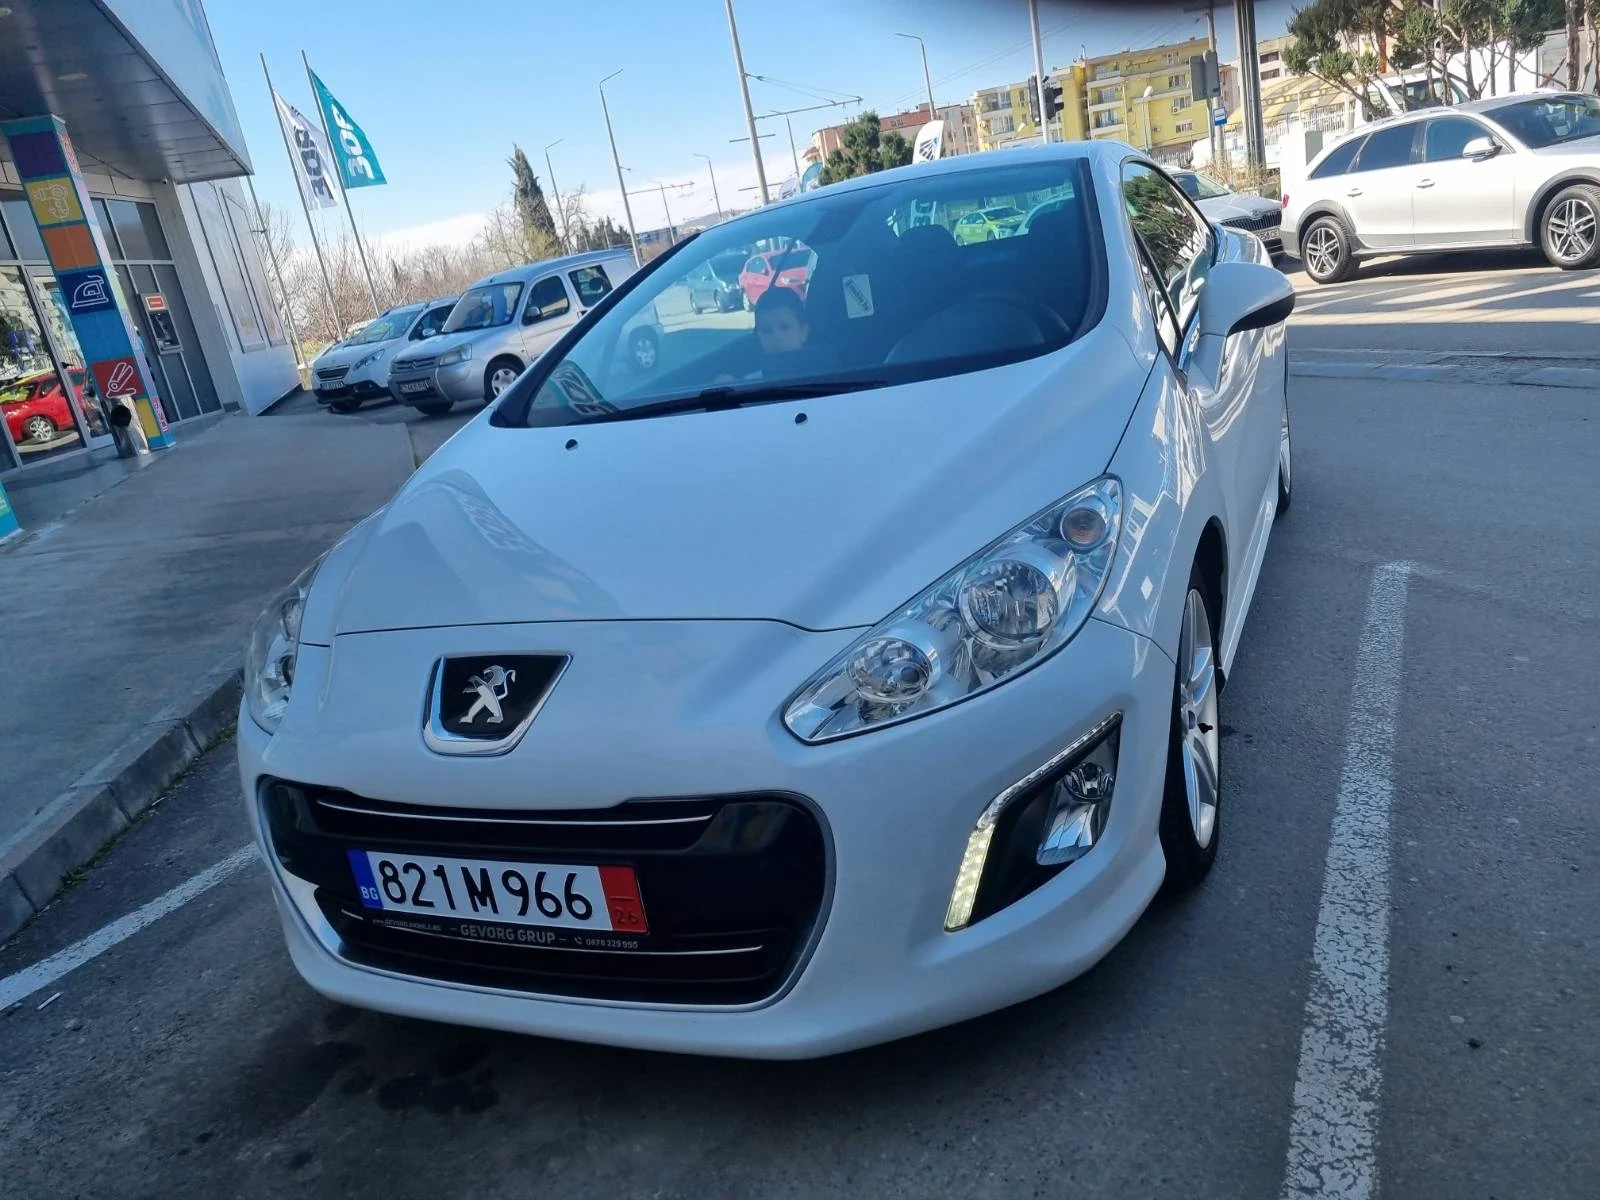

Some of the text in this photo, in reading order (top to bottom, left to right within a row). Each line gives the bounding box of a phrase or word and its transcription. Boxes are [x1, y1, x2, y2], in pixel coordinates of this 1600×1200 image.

[361, 885, 379, 901] BG
[460, 924, 515, 941] GEVORG
[517, 929, 556, 944] GRUP
